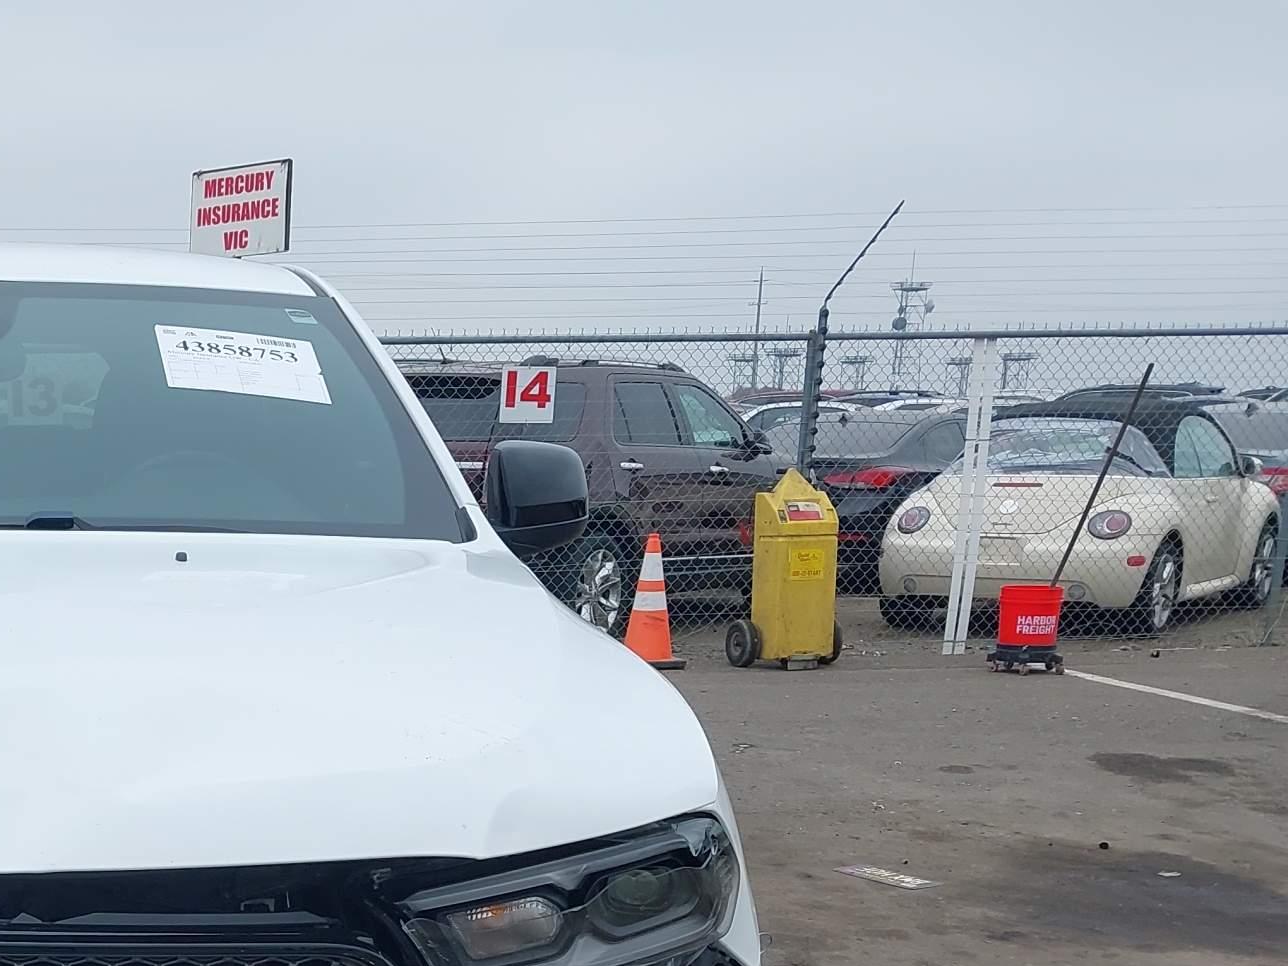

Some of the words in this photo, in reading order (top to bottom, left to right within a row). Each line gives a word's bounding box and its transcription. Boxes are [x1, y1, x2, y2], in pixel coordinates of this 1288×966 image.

[204, 171, 275, 199] MERCURY
[197, 198, 280, 227] INSURANCE
[223, 229, 249, 251] VIC
[175, 340, 299, 363] 43858753
[11, 377, 58, 417] 13
[505, 370, 552, 409] 14
[1016, 624, 1056, 635] FREIGHT
